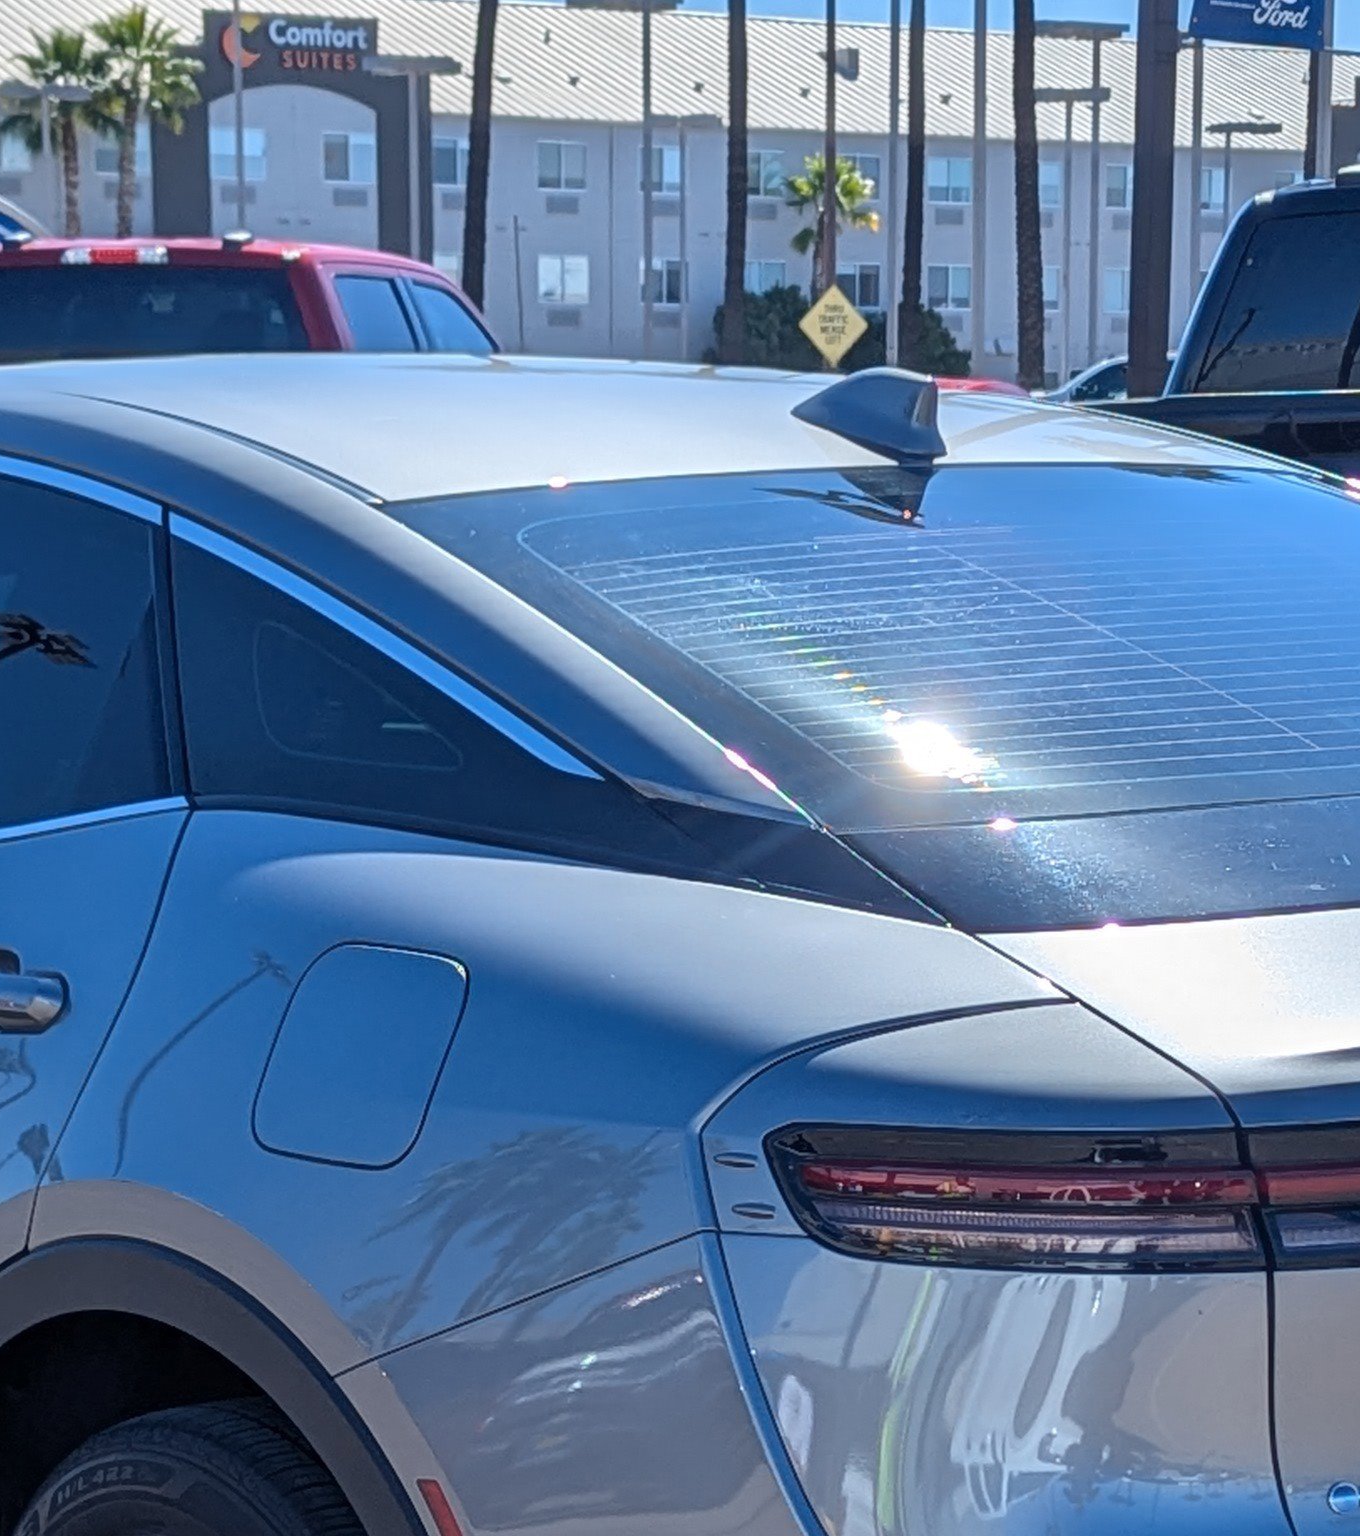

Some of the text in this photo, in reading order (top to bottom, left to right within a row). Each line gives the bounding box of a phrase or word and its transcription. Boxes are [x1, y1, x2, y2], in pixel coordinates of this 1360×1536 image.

[1252, 0, 1311, 29] Ford
[268, 18, 368, 49] Comfort
[281, 50, 358, 71] SUITES
